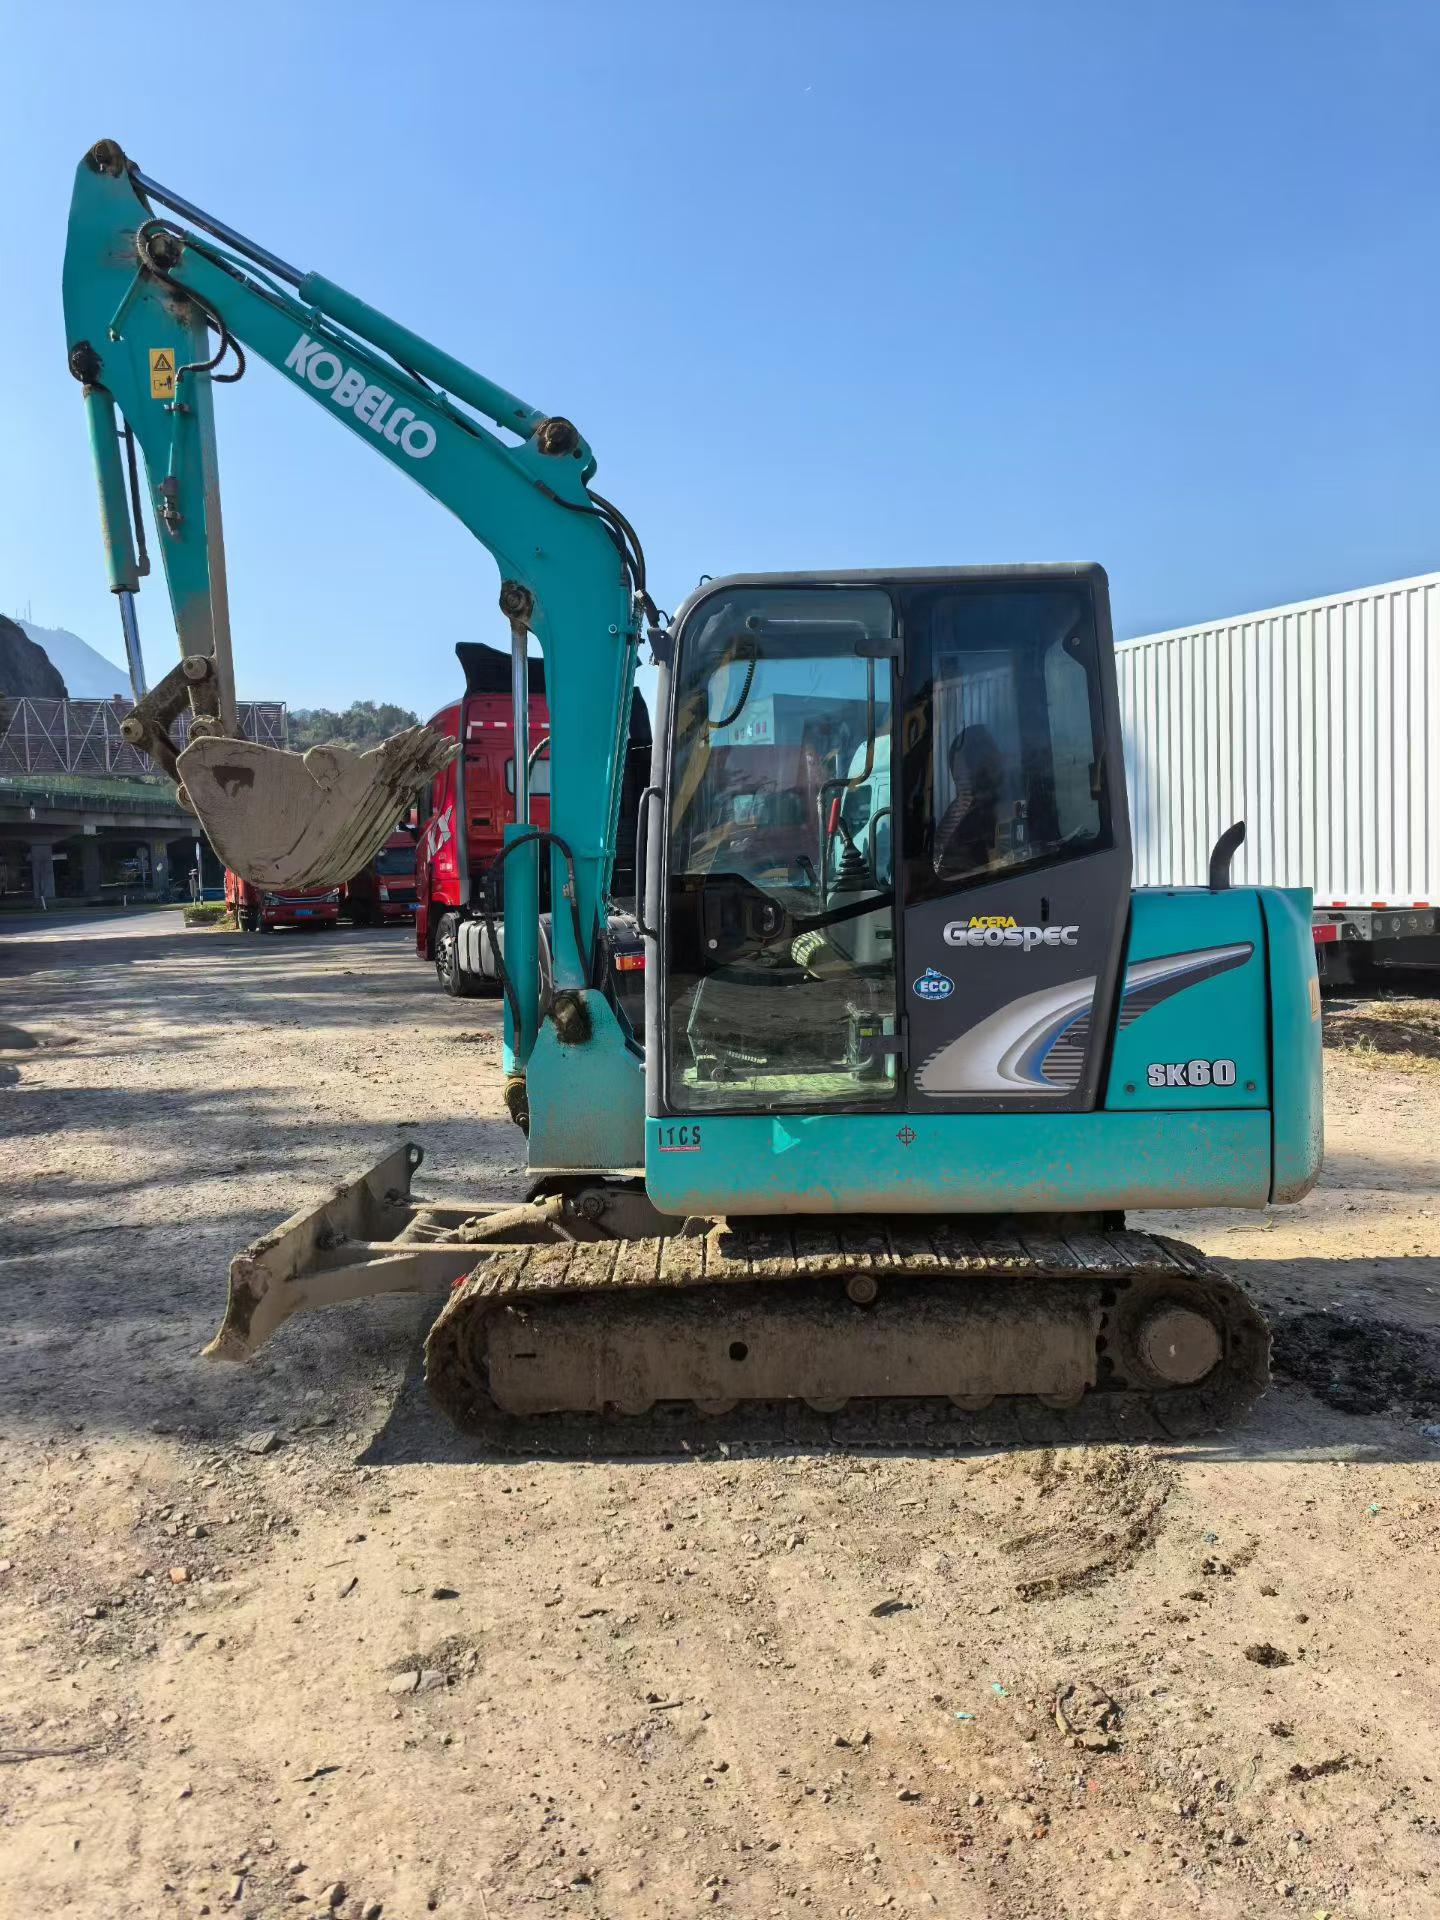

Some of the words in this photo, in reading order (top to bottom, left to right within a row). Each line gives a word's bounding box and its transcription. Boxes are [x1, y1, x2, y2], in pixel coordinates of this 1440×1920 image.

[284, 333, 437, 458] KOBELCO
[968, 916, 1018, 928] ACERA
[920, 981, 950, 993] ECO
[1147, 1059, 1236, 1087] SK60
[658, 1125, 701, 1146] ITCS
